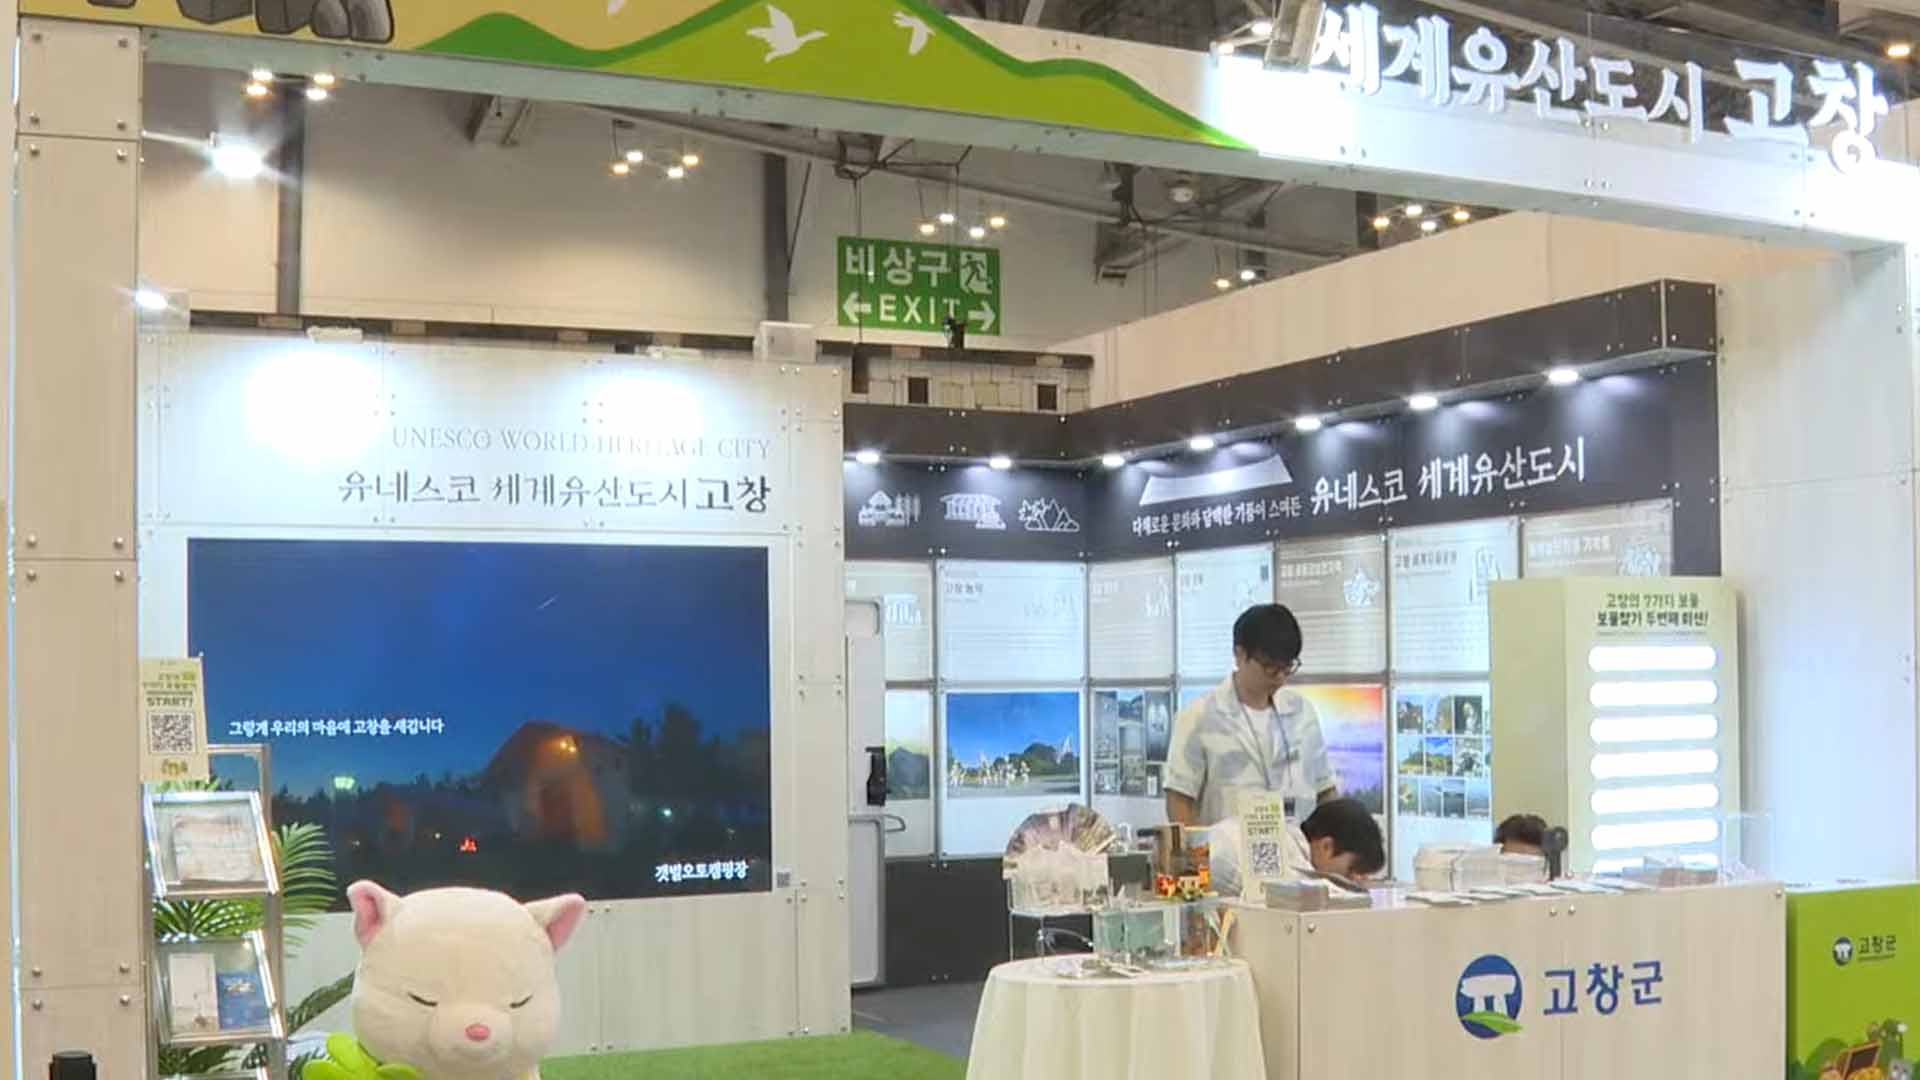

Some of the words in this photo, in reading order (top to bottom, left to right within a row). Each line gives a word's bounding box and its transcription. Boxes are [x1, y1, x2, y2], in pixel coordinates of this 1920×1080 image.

[1312, 2, 1701, 144] 세계유산도시
[1723, 56, 1888, 174] 고창
[845, 244, 950, 288] 비상구
[879, 293, 960, 325] EXIT
[392, 426, 492, 451] UNESCO
[500, 429, 588, 453] WORLD
[717, 438, 770, 460] CITY
[339, 469, 481, 504] 유네스코
[492, 471, 687, 509] 세계유산도시
[696, 475, 771, 513] 고창
[1310, 467, 1407, 516] 유네스코
[1418, 435, 1586, 500] 세계유산도시
[1606, 592, 1640, 608] 고창의
[1597, 610, 1642, 626] 보물찾기
[229, 719, 268, 737] 그렇게
[270, 718, 310, 736] 우리의
[311, 718, 351, 736] 마음에
[353, 717, 392, 736] 고창을
[655, 859, 749, 883] 갯벌오토캠핑장
[1858, 933, 1897, 955] 고창군
[1543, 960, 1664, 1016] 고창군
